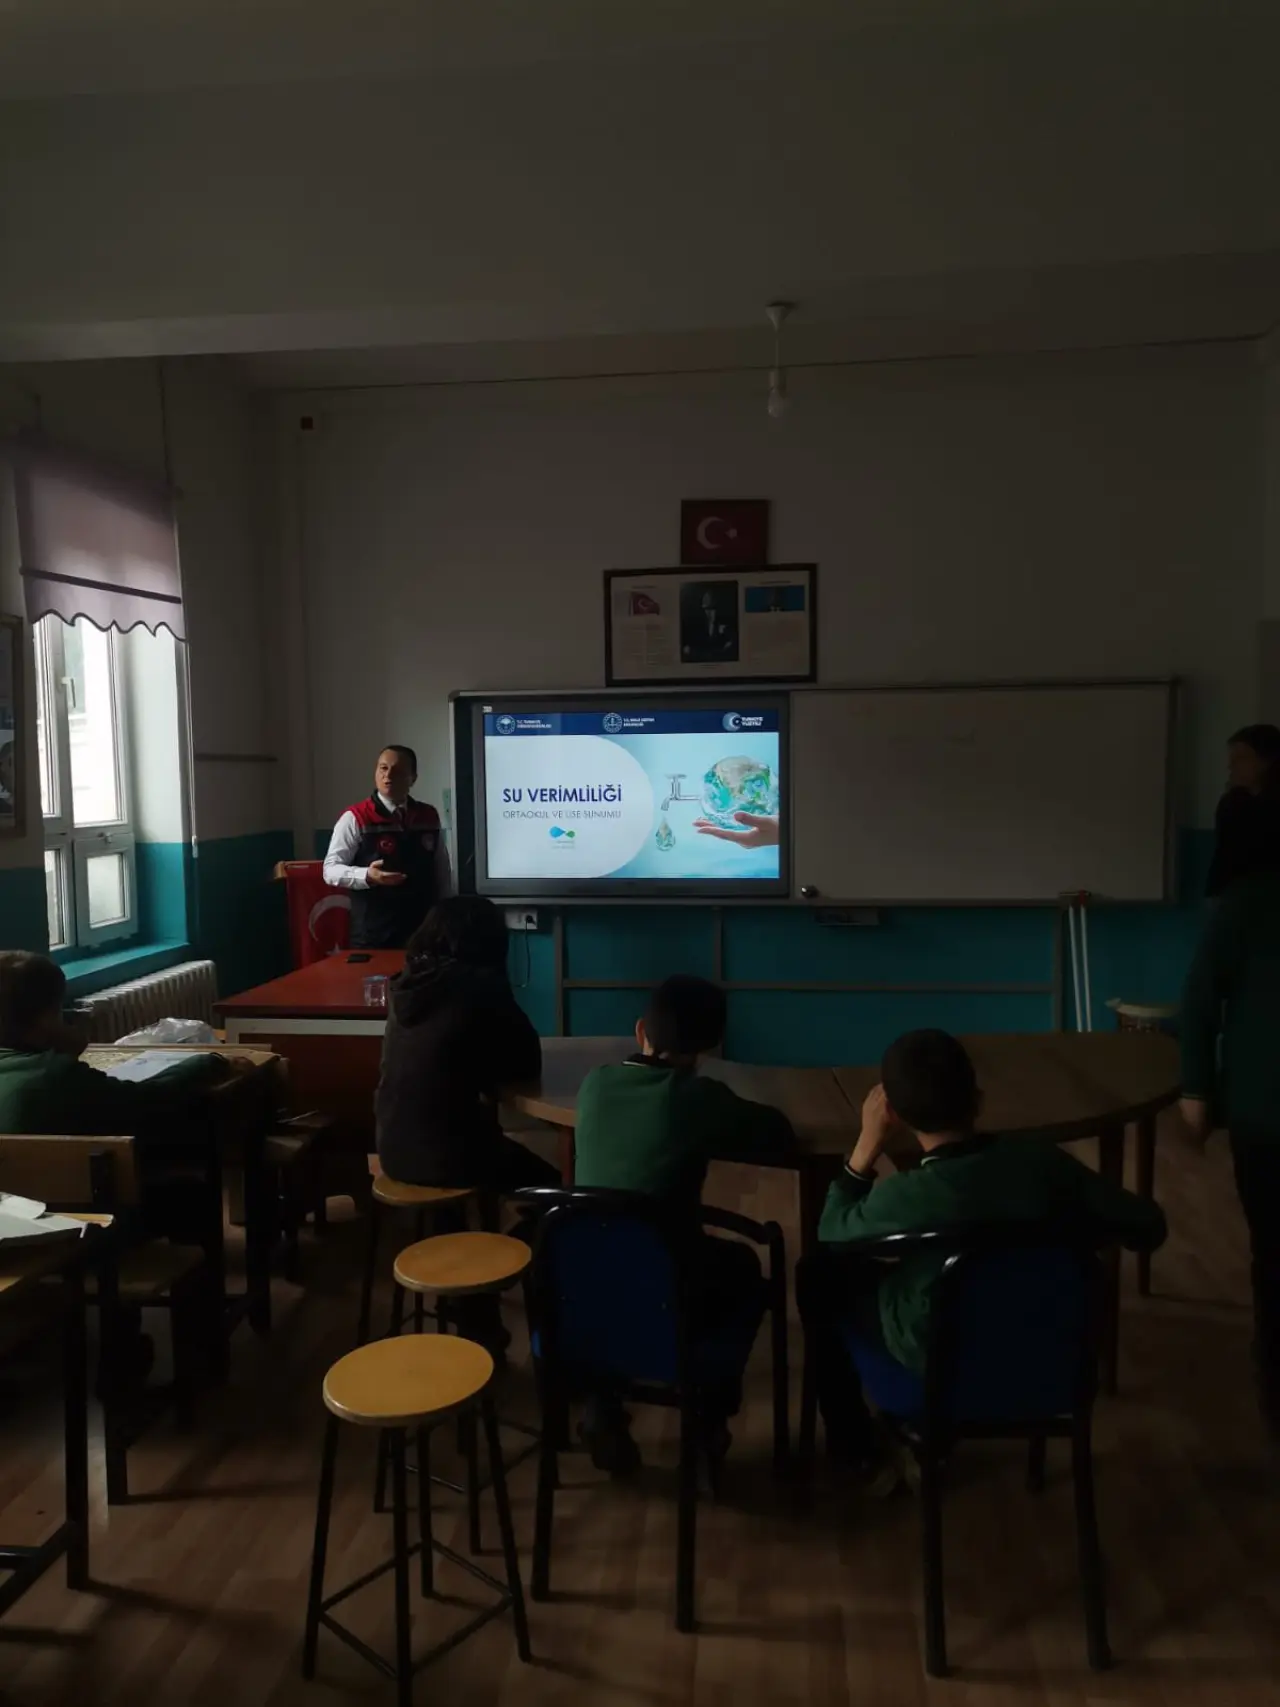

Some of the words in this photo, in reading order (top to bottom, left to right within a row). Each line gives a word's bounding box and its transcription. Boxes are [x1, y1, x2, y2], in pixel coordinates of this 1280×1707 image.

[503, 788, 522, 803] SU
[528, 784, 622, 802] VERİMLİLİĞİ
[503, 810, 549, 819] ORTAOKUL
[552, 810, 562, 819] VE
[584, 810, 621, 819] SUNUMU
